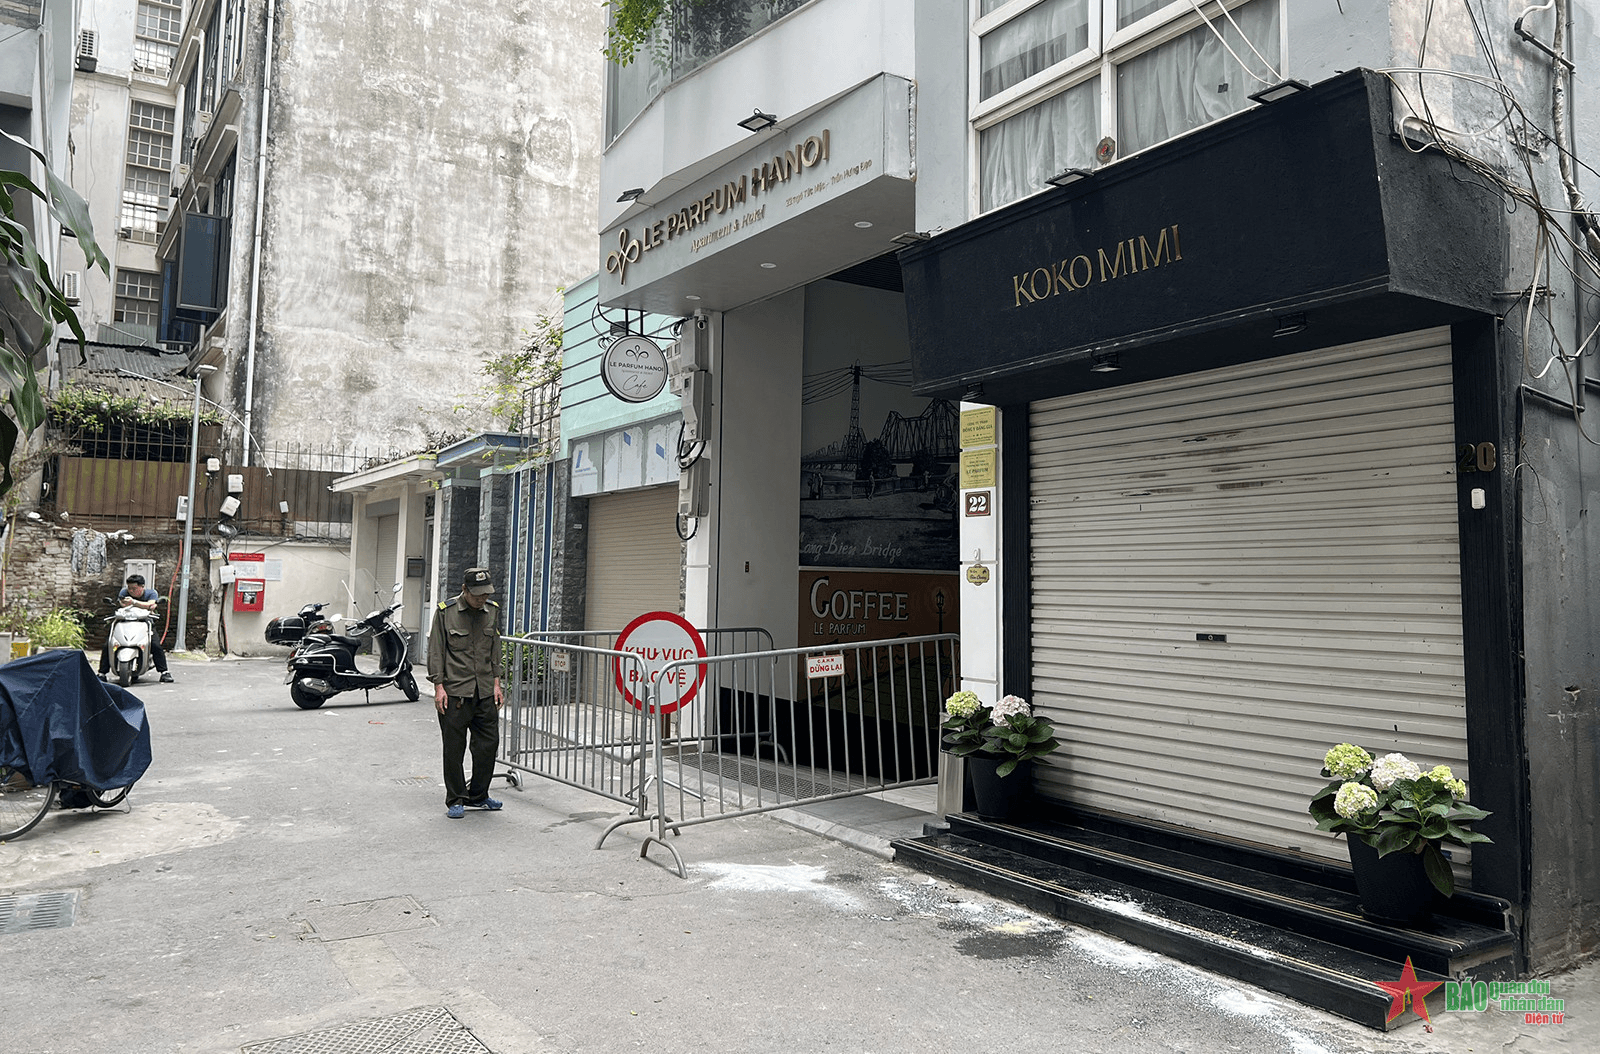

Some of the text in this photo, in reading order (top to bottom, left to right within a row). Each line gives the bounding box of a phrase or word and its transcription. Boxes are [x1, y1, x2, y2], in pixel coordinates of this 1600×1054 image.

[643, 129, 830, 252] LE PARFUM HANOI
[690, 204, 766, 253] Apartment & Hotel
[1012, 224, 1183, 307] KOKO MIMI
[618, 362, 643, 370] PARFUM
[1459, 441, 1497, 473] 20
[969, 495, 987, 512] 22
[861, 536, 902, 563] Bridge
[810, 577, 909, 621] COFFEE
[814, 622, 867, 635] LE PARFUM
